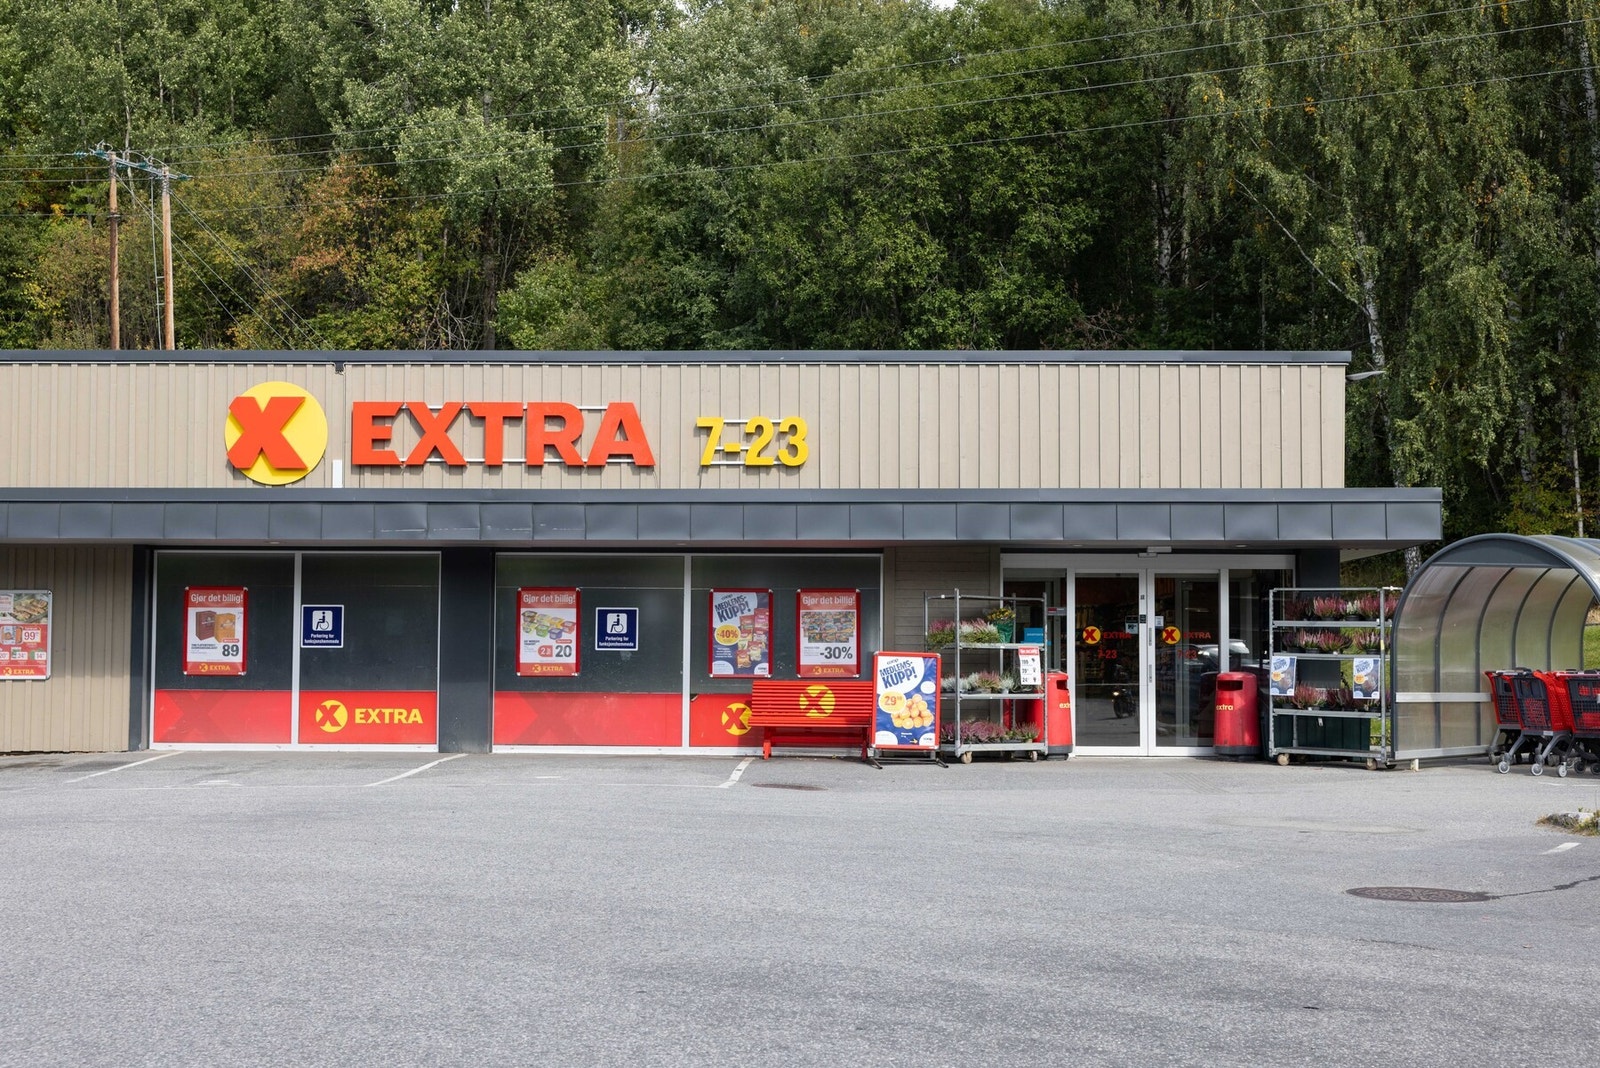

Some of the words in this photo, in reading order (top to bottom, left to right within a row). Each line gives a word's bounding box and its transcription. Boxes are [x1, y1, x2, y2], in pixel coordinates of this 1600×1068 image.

[352, 401, 656, 466] EXTRA
[696, 416, 809, 467] 7-23
[191, 593, 206, 604] Gjør
[208, 594, 221, 602] det
[222, 593, 244, 604] billig!
[523, 594, 539, 604] Gjør
[540, 594, 554, 603] det
[555, 594, 576, 604] billig!
[714, 594, 747, 613] MEDLEMS-
[803, 596, 818, 606] Gjør
[820, 596, 833, 604] det
[834, 596, 856, 606] billig!
[717, 600, 751, 623] KUPP!
[717, 629, 738, 639] -40%
[1103, 631, 1132, 639] EXTRA
[1183, 631, 1212, 639] EXTRA
[222, 644, 240, 657] 89
[555, 645, 572, 657] 20
[820, 646, 853, 659] -30%
[1098, 649, 1118, 659] 7-23
[879, 660, 913, 677] MEDLEMS-
[881, 666, 918, 689] KUPP!
[354, 708, 424, 724] EXTRA
